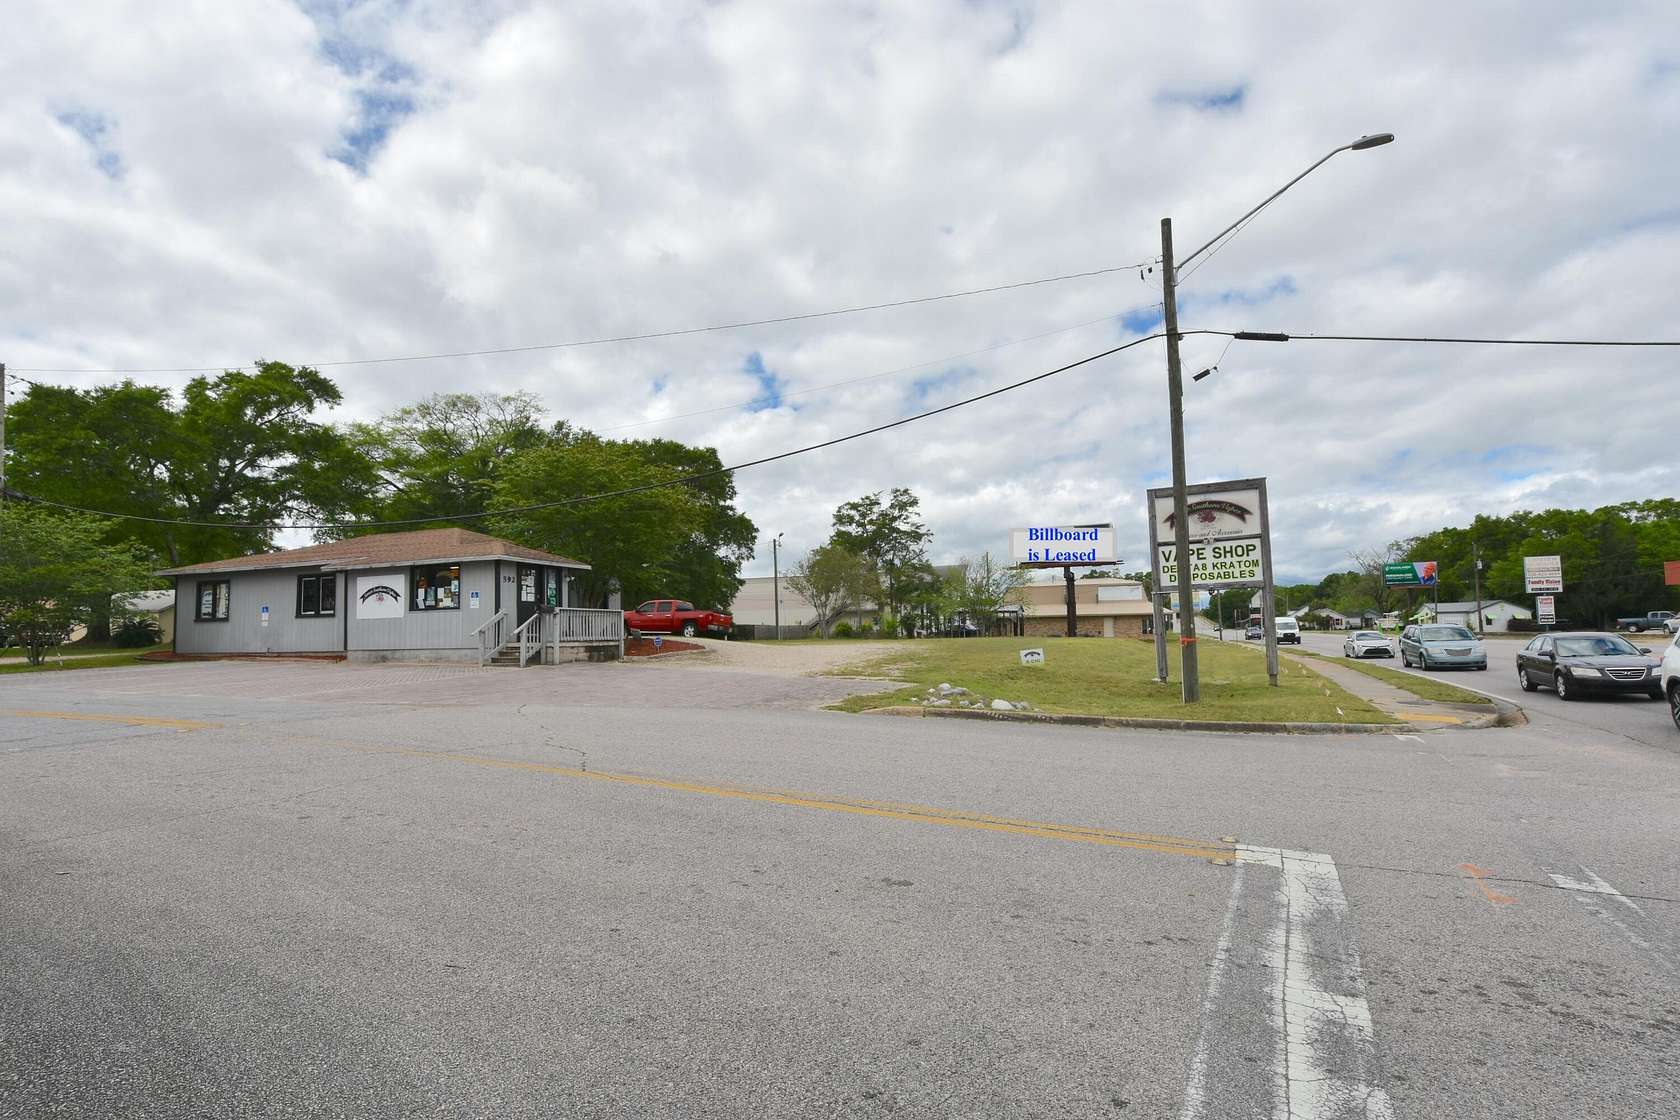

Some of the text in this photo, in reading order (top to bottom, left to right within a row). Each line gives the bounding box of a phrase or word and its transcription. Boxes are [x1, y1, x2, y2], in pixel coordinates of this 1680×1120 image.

[1212, 544, 1257, 558] SHOP
[1162, 560, 1259, 573] DEA8 KRATOM
[503, 575, 515, 584] 592
[1169, 570, 1255, 582] DPOSABLES
